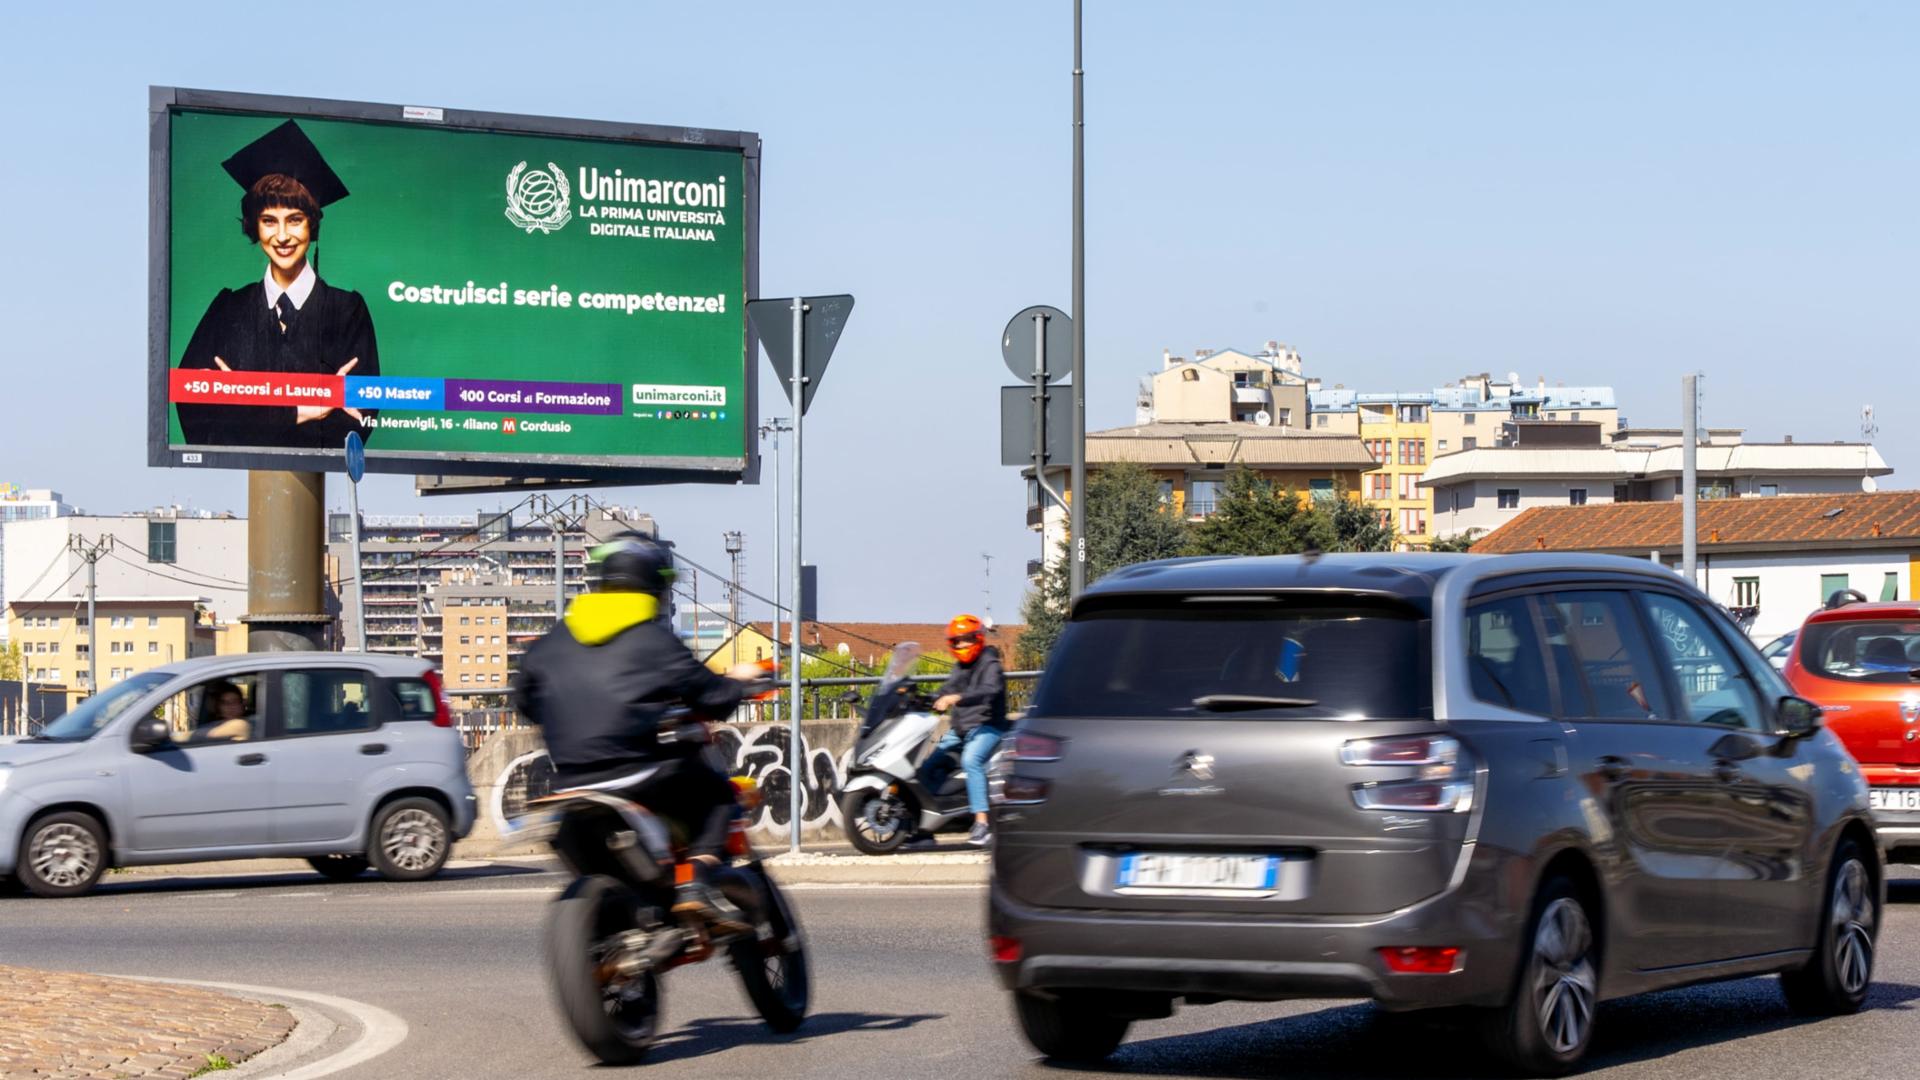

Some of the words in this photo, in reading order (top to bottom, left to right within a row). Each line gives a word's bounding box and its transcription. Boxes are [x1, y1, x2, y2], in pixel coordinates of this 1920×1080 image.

[580, 167, 725, 208] Unimarconi
[579, 205, 598, 218] LA
[601, 207, 643, 220] PRIMA
[647, 210, 725, 225] UNIVERSITÀ
[590, 223, 650, 237] DIGITALE
[654, 227, 715, 241] ITALIANA
[388, 281, 507, 305] Costruisci
[514, 285, 572, 307] serie
[578, 293, 726, 314] competenze!
[184, 381, 209, 393] +50
[214, 382, 270, 396] Percorsi
[274, 387, 282, 396] di
[286, 385, 331, 398] Laurea
[358, 387, 382, 399] +50
[386, 387, 431, 400] Master
[488, 390, 521, 403] Corsi
[524, 394, 532, 403] di
[536, 392, 610, 406] Formazione
[636, 388, 722, 402] unimarconi.it
[359, 415, 378, 428] Via
[381, 417, 438, 431] Meravigli,
[441, 418, 453, 430] 16
[520, 420, 571, 433] Cordusio
[1899, 790, 1920, 808] 16
